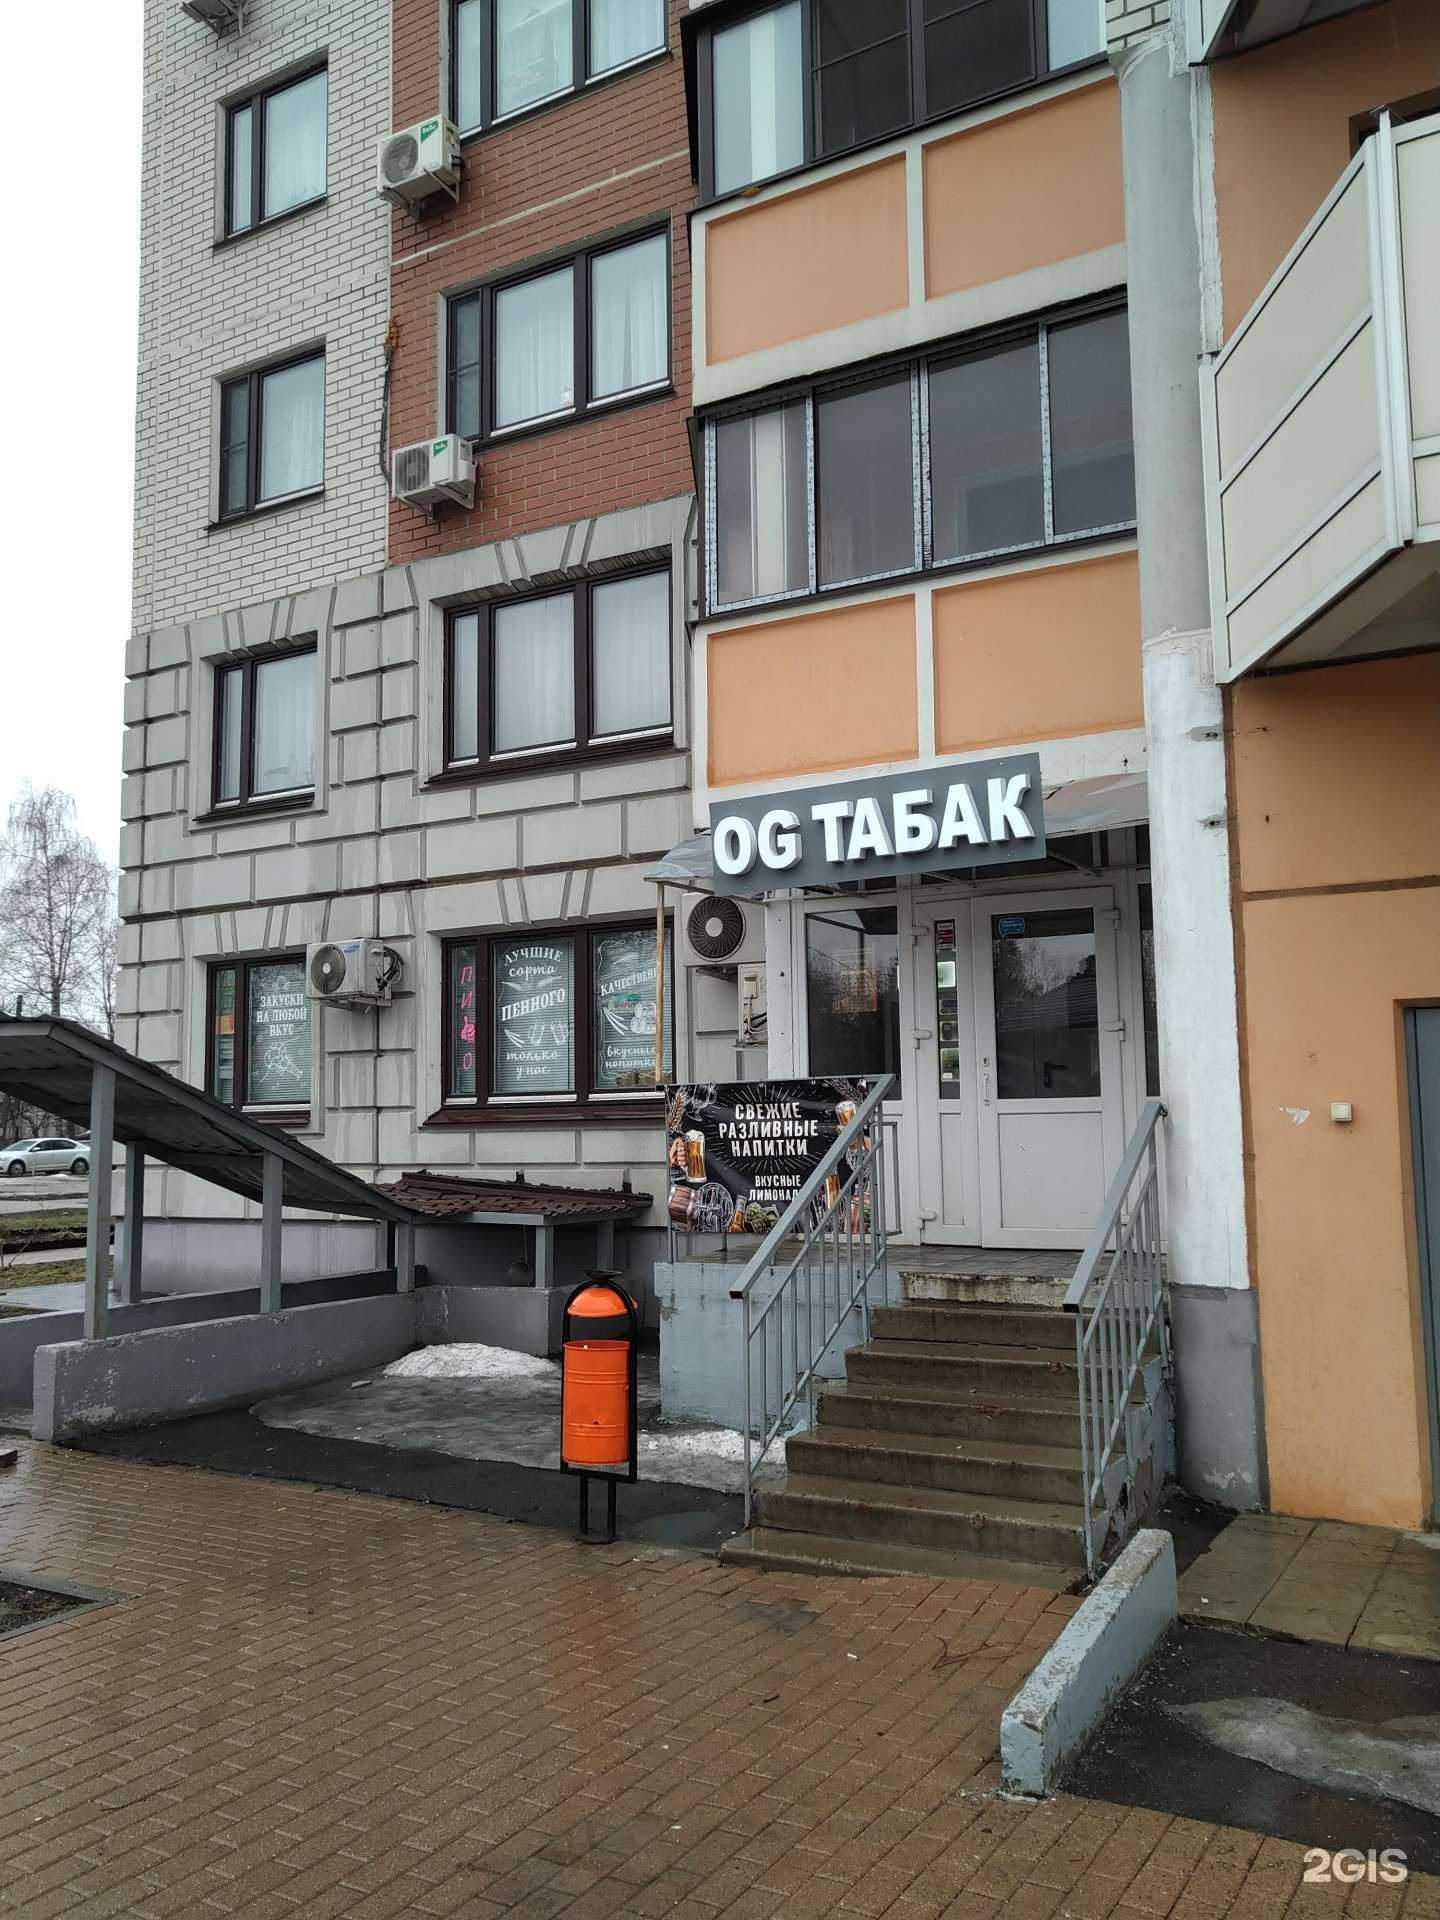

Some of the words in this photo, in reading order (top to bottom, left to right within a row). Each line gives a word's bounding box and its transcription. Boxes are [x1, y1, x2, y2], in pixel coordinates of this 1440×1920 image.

[713, 808, 802, 875] OG
[811, 773, 1036, 864] ТАБАК
[503, 946, 563, 967] ЛУЧШИЕ
[508, 964, 559, 981] сорта
[260, 993, 304, 1008] ЗАКУСКИ
[501, 987, 566, 1022] ПЕННОГО
[256, 1010, 270, 1023] НА
[272, 1005, 307, 1022] ЛЮБОЙ
[461, 966, 477, 1071] ПИО
[269, 1023, 294, 1037] ВКУС
[506, 1049, 560, 1061] только
[735, 1102, 802, 1120] СВЕЖИЕ
[719, 1119, 819, 1139] РАЗЛИВНЫЕ
[731, 1139, 808, 1157] НАПИТКИ
[755, 1174, 801, 1187] ВКУСНЫЕ
